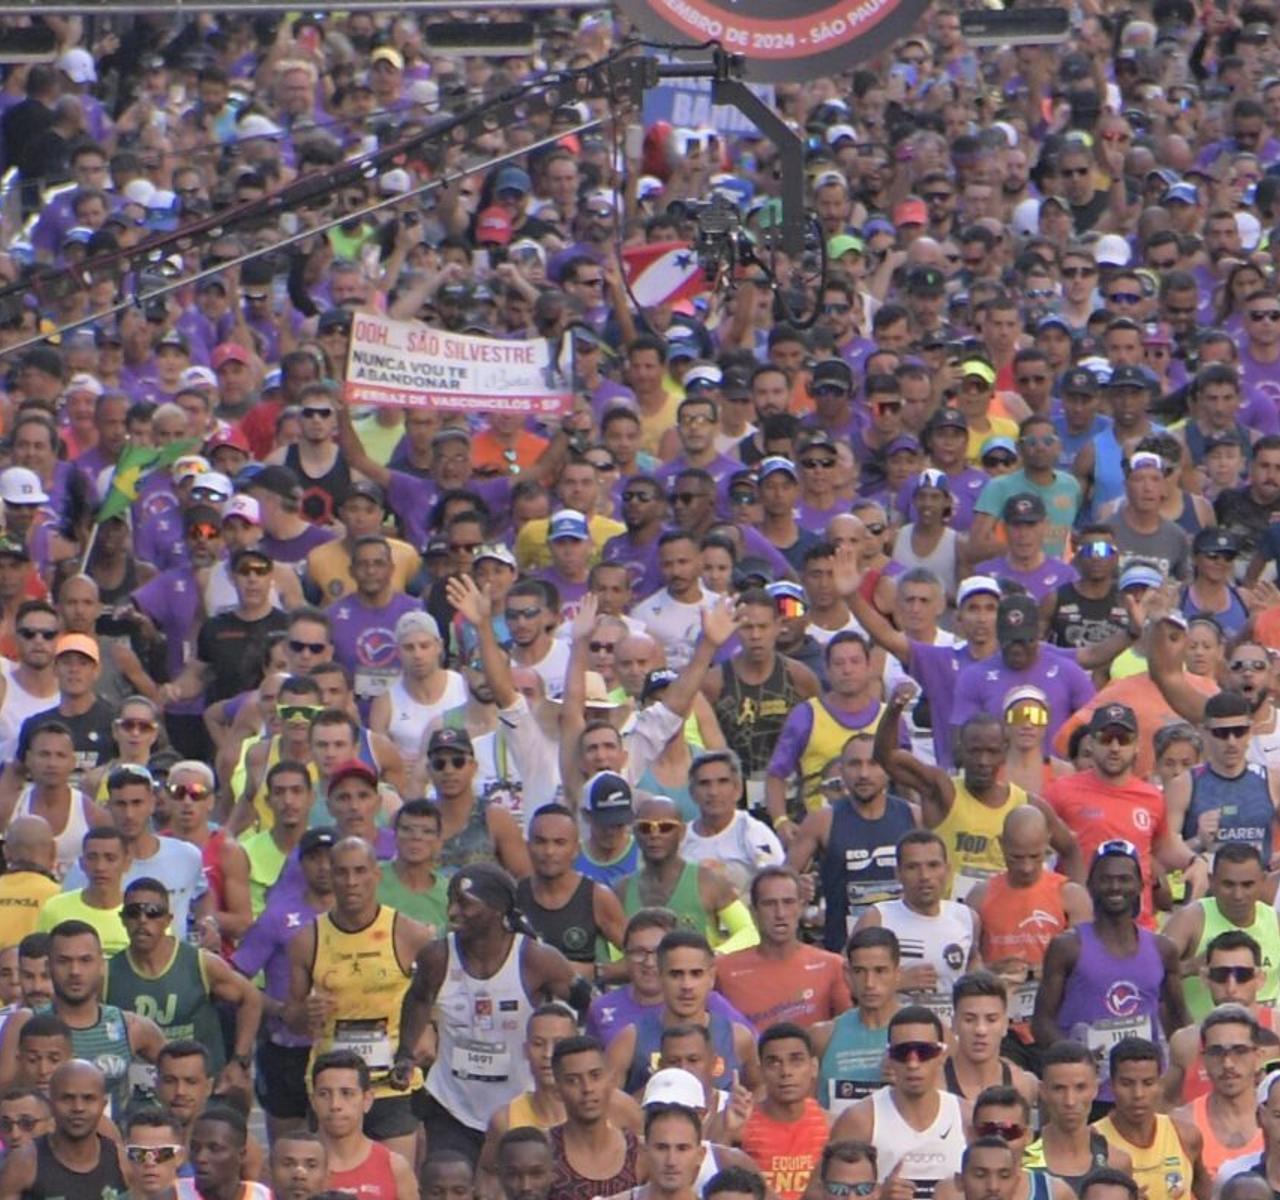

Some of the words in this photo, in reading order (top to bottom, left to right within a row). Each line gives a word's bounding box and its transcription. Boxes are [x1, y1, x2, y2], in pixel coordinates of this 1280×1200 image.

[725, 28, 747, 46] DE
[753, 32, 796, 49] 2024
[811, 23, 849, 46] SÃO
[407, 327, 439, 356] SÃO
[445, 339, 535, 364] SILVESTRE
[353, 349, 406, 371] NUNCA
[410, 360, 445, 376] VOU
[449, 365, 468, 378] TE
[356, 367, 460, 390] ABANDONAR
[772, 1155, 815, 1171] EQUIPE
